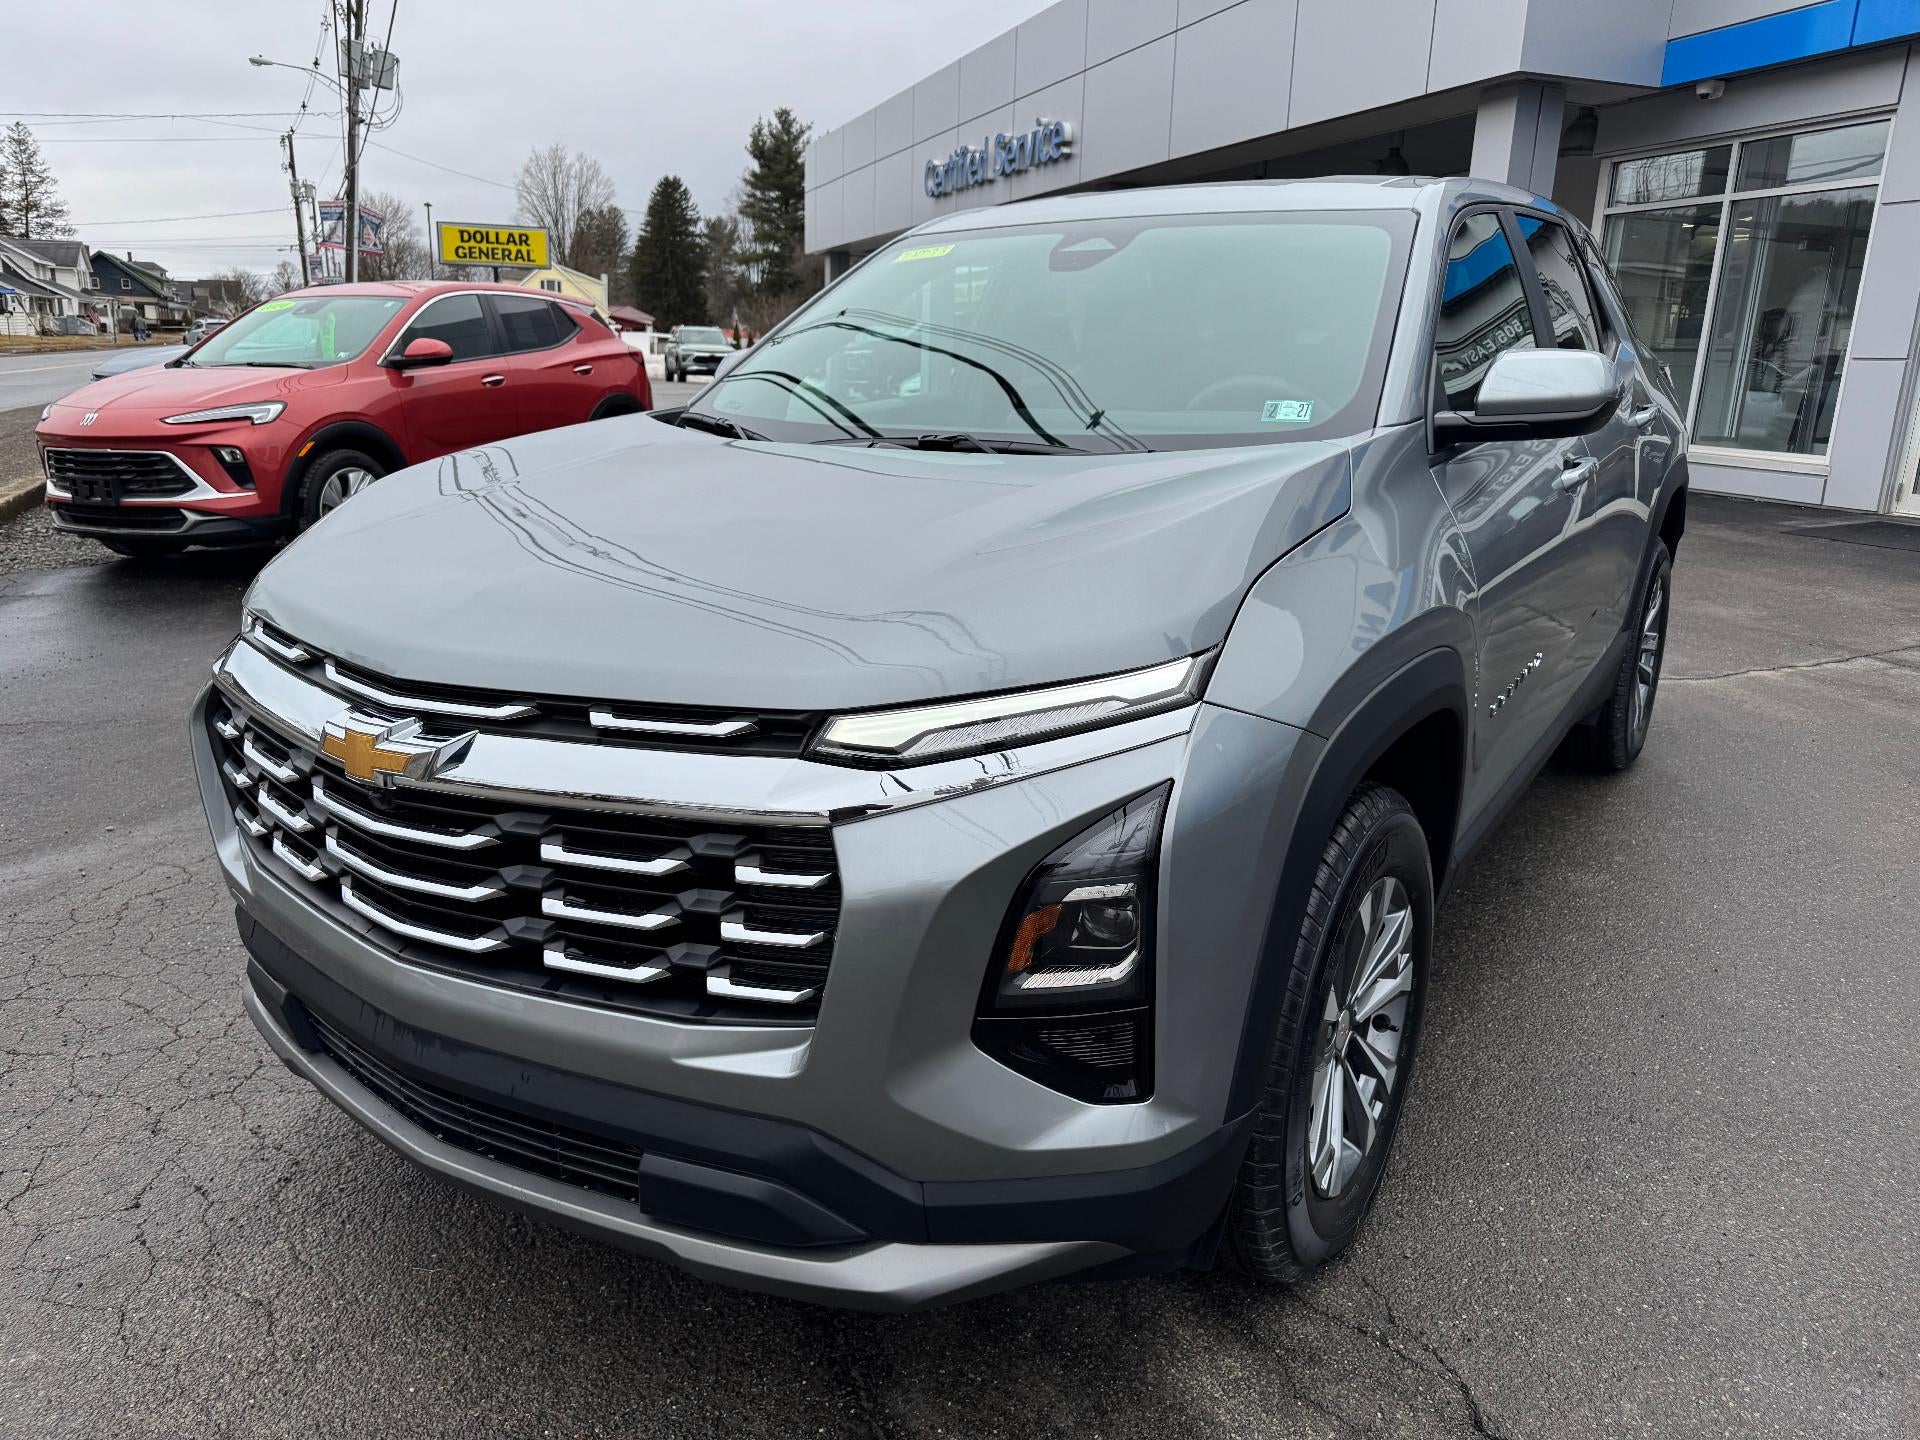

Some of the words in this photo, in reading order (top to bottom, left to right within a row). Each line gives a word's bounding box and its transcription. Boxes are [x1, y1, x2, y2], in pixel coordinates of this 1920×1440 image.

[924, 136, 989, 198] Certified
[993, 117, 1070, 177] Service
[458, 229, 531, 247] DOLLAR
[454, 245, 537, 263] GENERAL
[1296, 403, 1310, 418] 27
